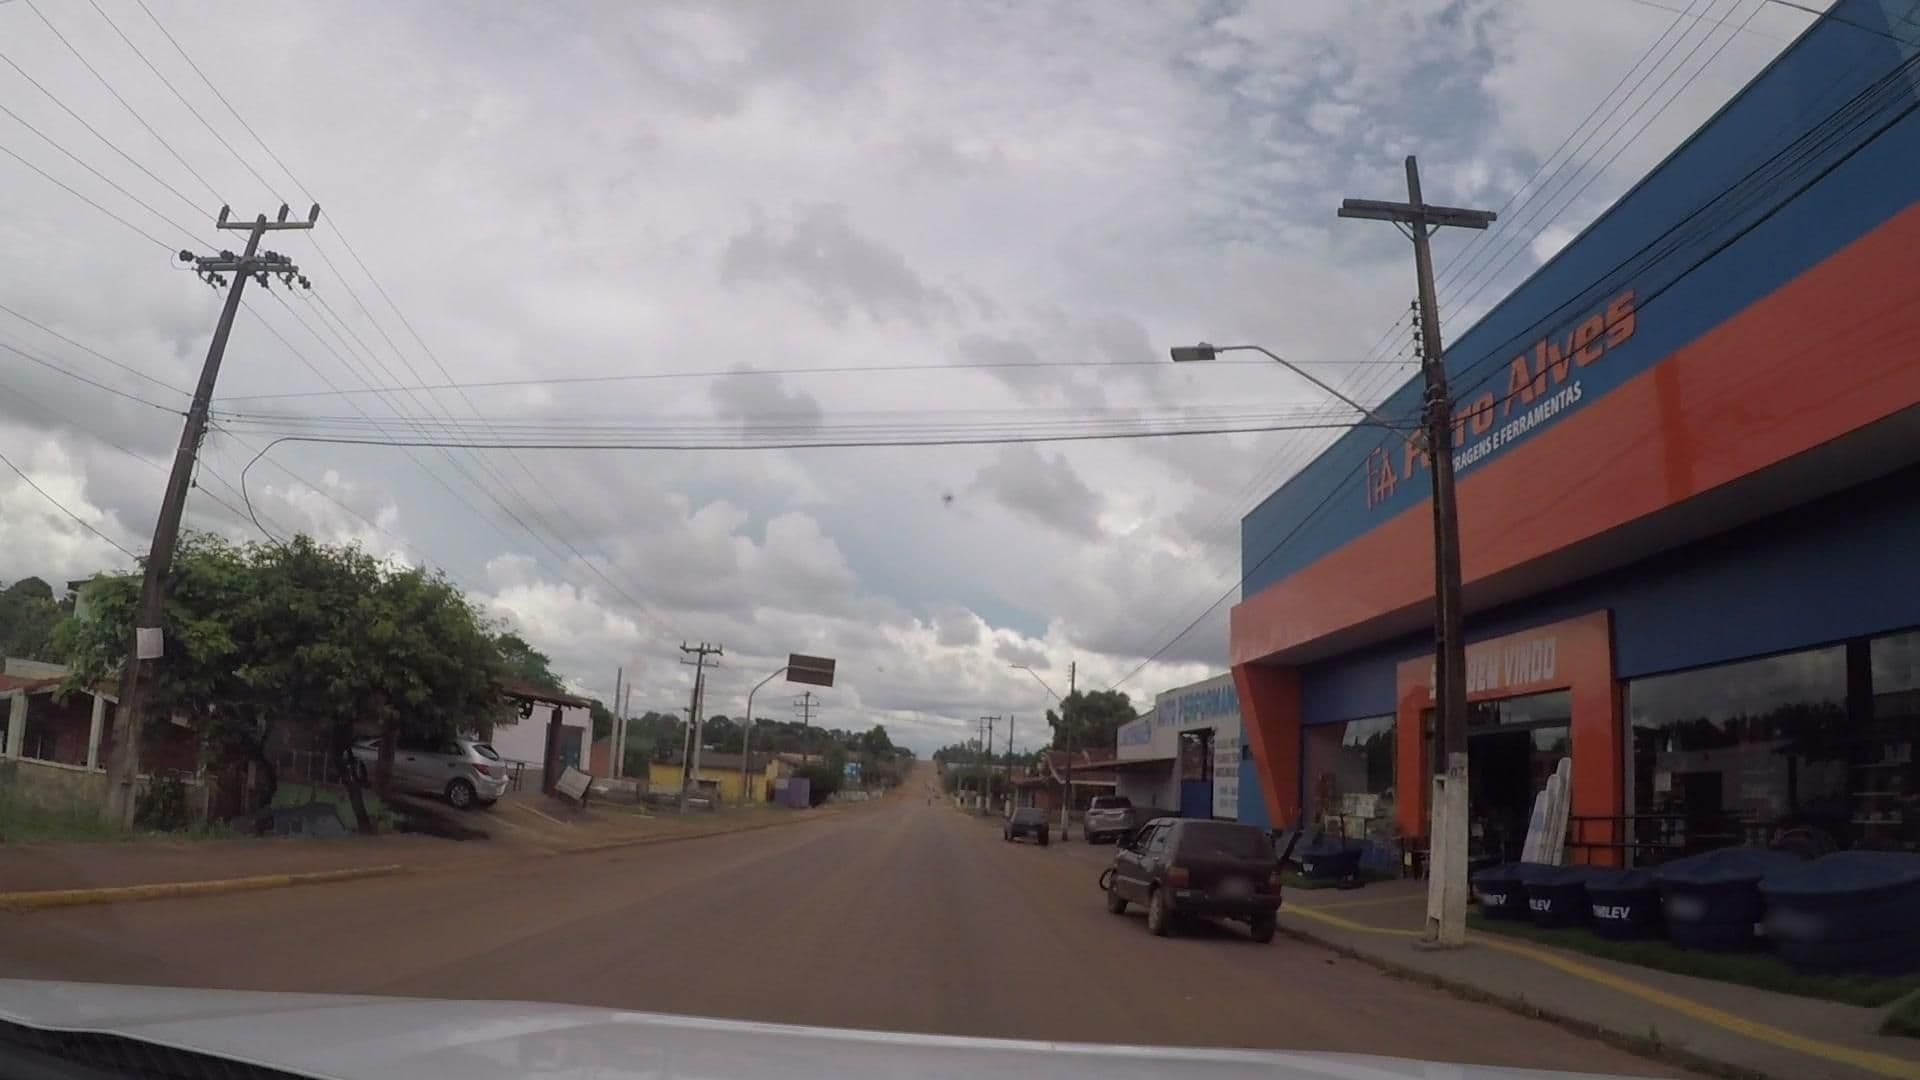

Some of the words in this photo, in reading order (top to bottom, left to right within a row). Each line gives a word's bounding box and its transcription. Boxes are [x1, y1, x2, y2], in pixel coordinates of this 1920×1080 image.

[1505, 289, 1637, 416] Alves
[1452, 439, 1493, 473] RAGENS
[1500, 380, 1583, 444] FERRAMENTAS
[1503, 637, 1557, 687] VINDO
